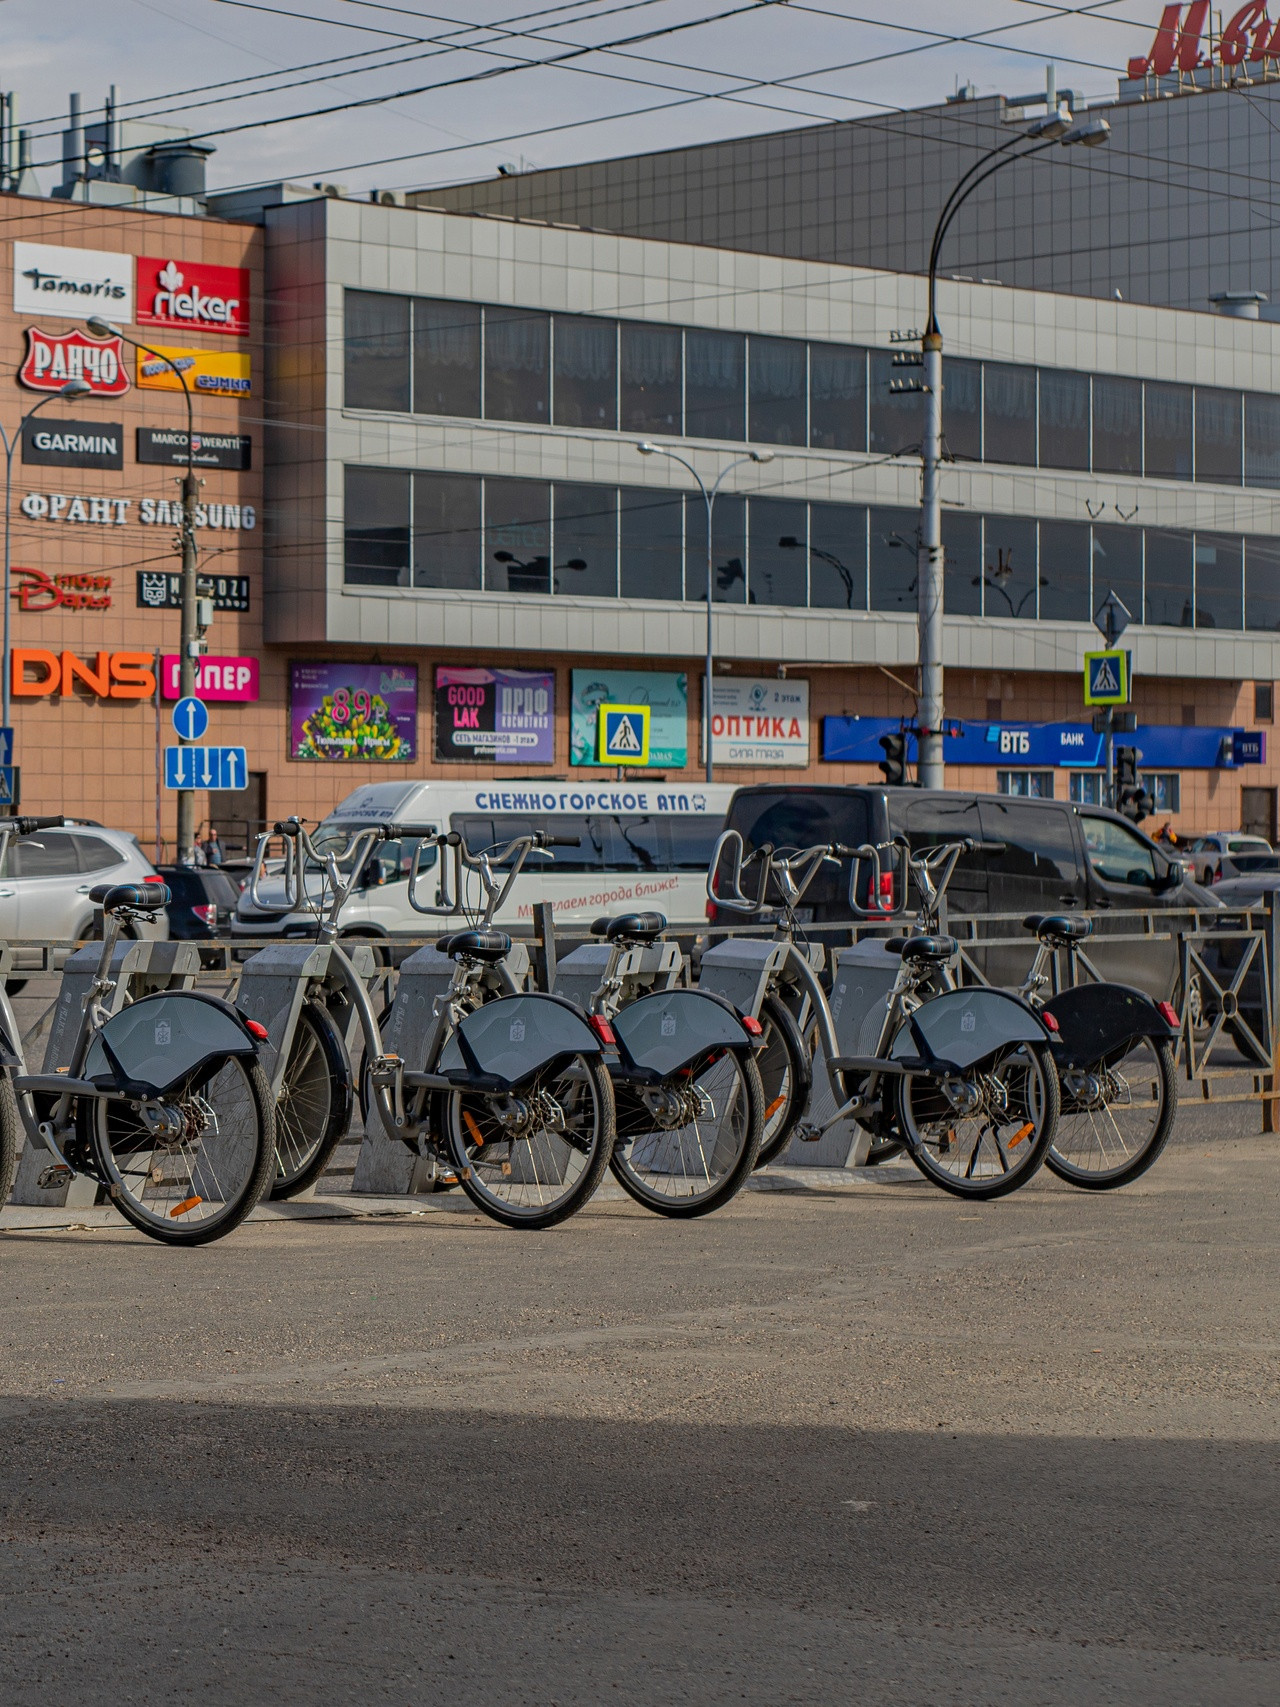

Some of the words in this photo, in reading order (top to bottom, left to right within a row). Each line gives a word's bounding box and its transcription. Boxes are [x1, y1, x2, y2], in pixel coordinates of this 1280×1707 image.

[154, 285, 239, 322] rieker
[33, 341, 118, 384] РАНЧО
[33, 431, 118, 455] GARMIN
[151, 433, 188, 445] MARCO
[21, 493, 130, 524] ФРАНТ
[12, 648, 157, 699] DNS
[332, 688, 371, 723] 89
[448, 686, 485, 706] GOOD
[502, 687, 548, 716] ПРОФ
[453, 706, 479, 729] LAK
[711, 714, 801, 738] ОПТИКА
[1001, 731, 1030, 754] ВТБ
[1061, 732, 1084, 746] БАНК
[475, 793, 648, 811] СНЕЖНОГОРСКОЕ
[657, 794, 690, 811] АТП
[589, 885, 632, 907] города
[635, 876, 680, 897] ближе!
